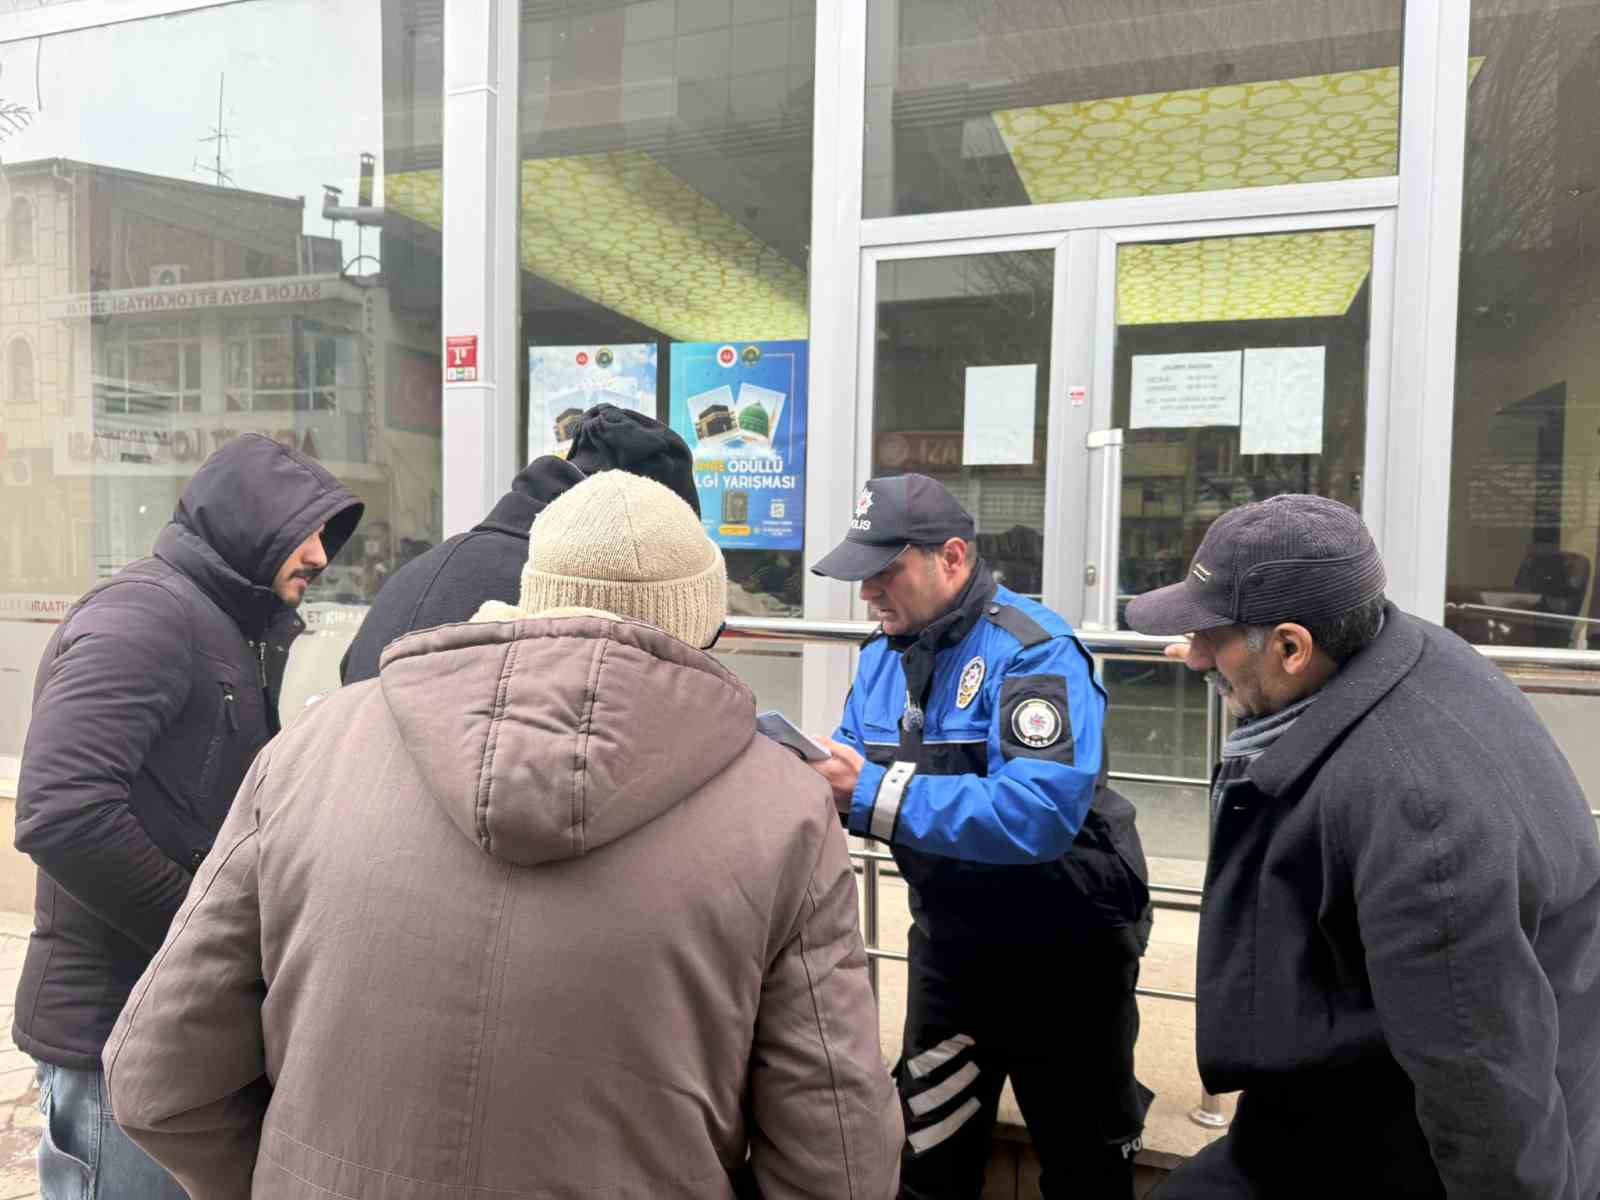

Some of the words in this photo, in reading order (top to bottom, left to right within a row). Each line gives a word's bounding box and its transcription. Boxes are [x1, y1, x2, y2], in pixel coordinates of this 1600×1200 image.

[694, 472, 719, 488] LGİ
[723, 475, 795, 490] YARIŞMASI
[1121, 1137, 1142, 1159] PO
